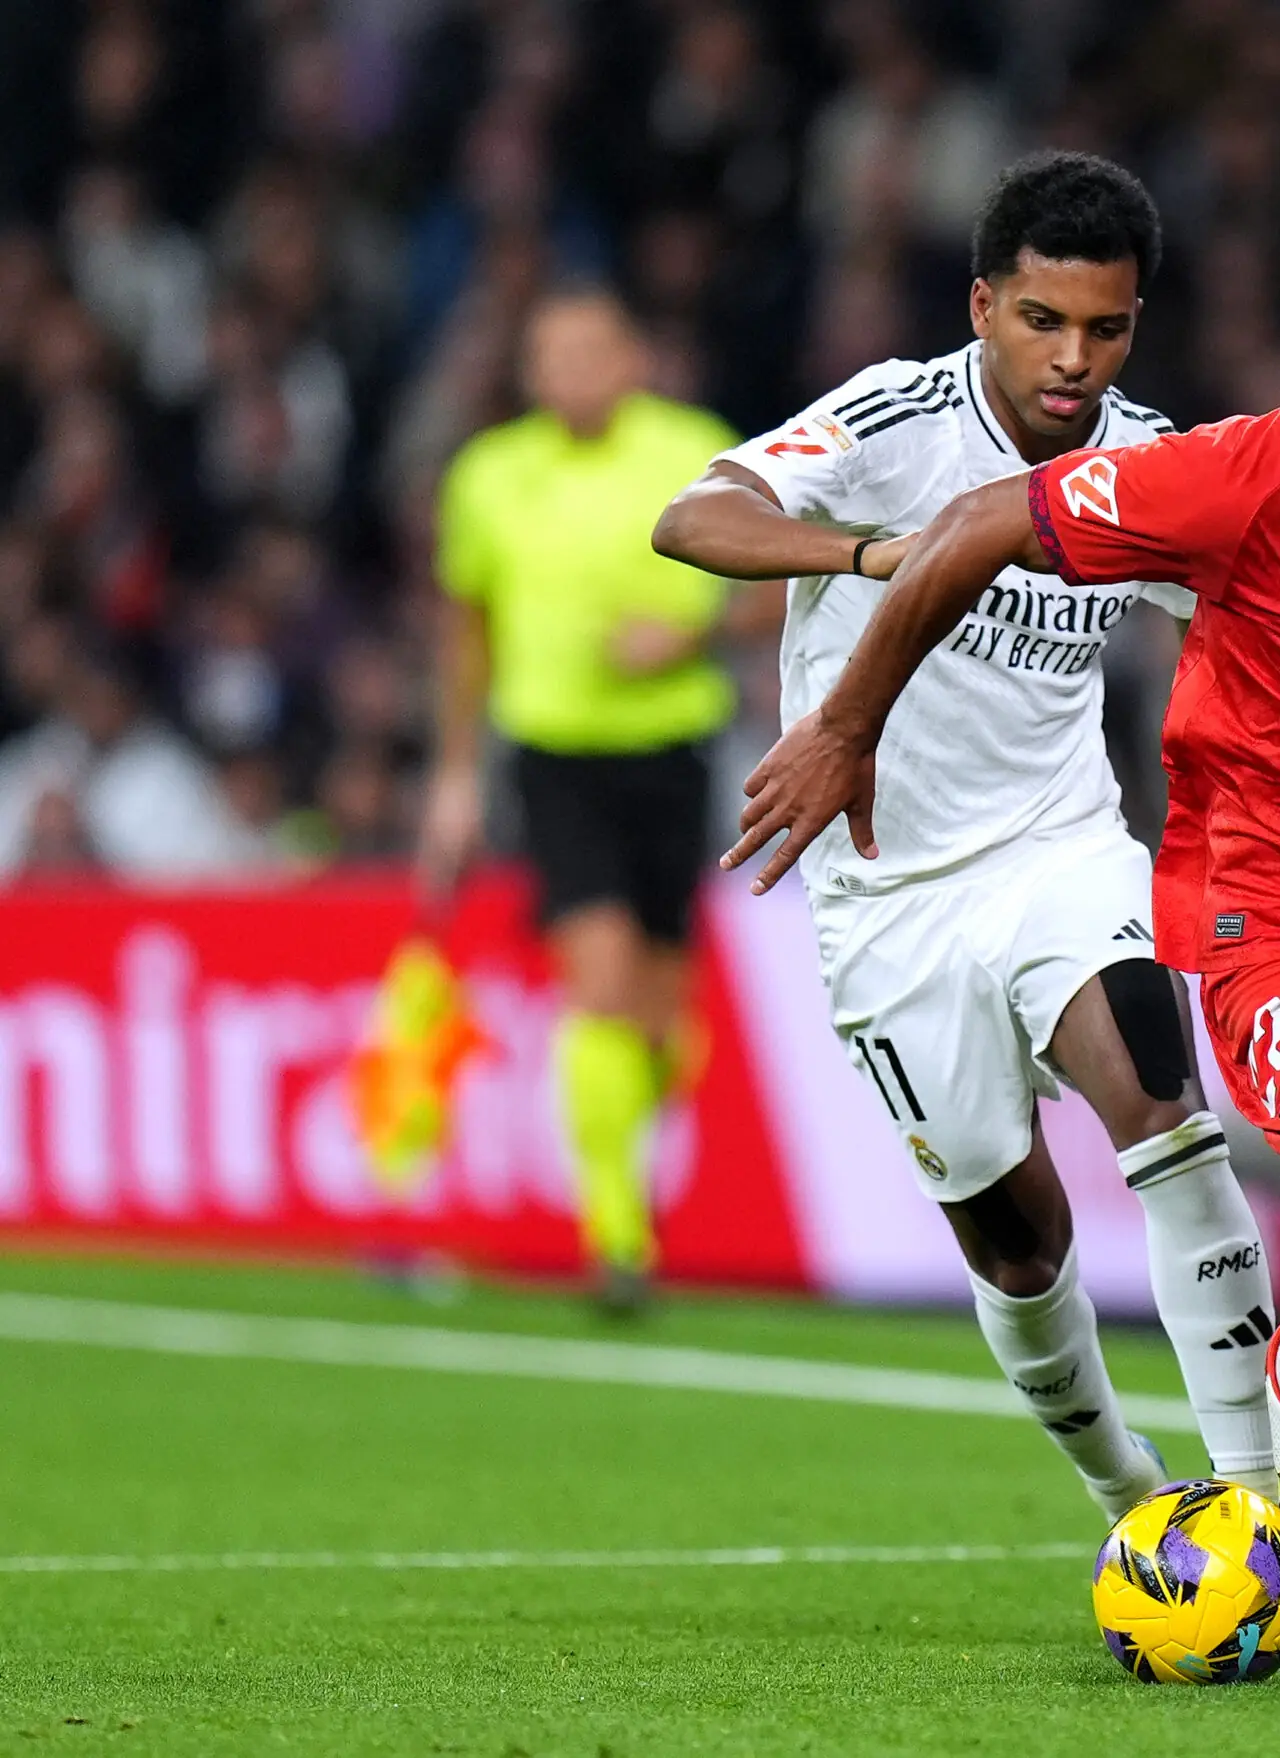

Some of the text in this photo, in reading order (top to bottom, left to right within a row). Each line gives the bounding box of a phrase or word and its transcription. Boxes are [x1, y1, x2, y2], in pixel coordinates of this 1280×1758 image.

[969, 579, 1133, 634] mirates
[950, 623, 1101, 675] FLY BETTER
[855, 1035, 927, 1122] 11
